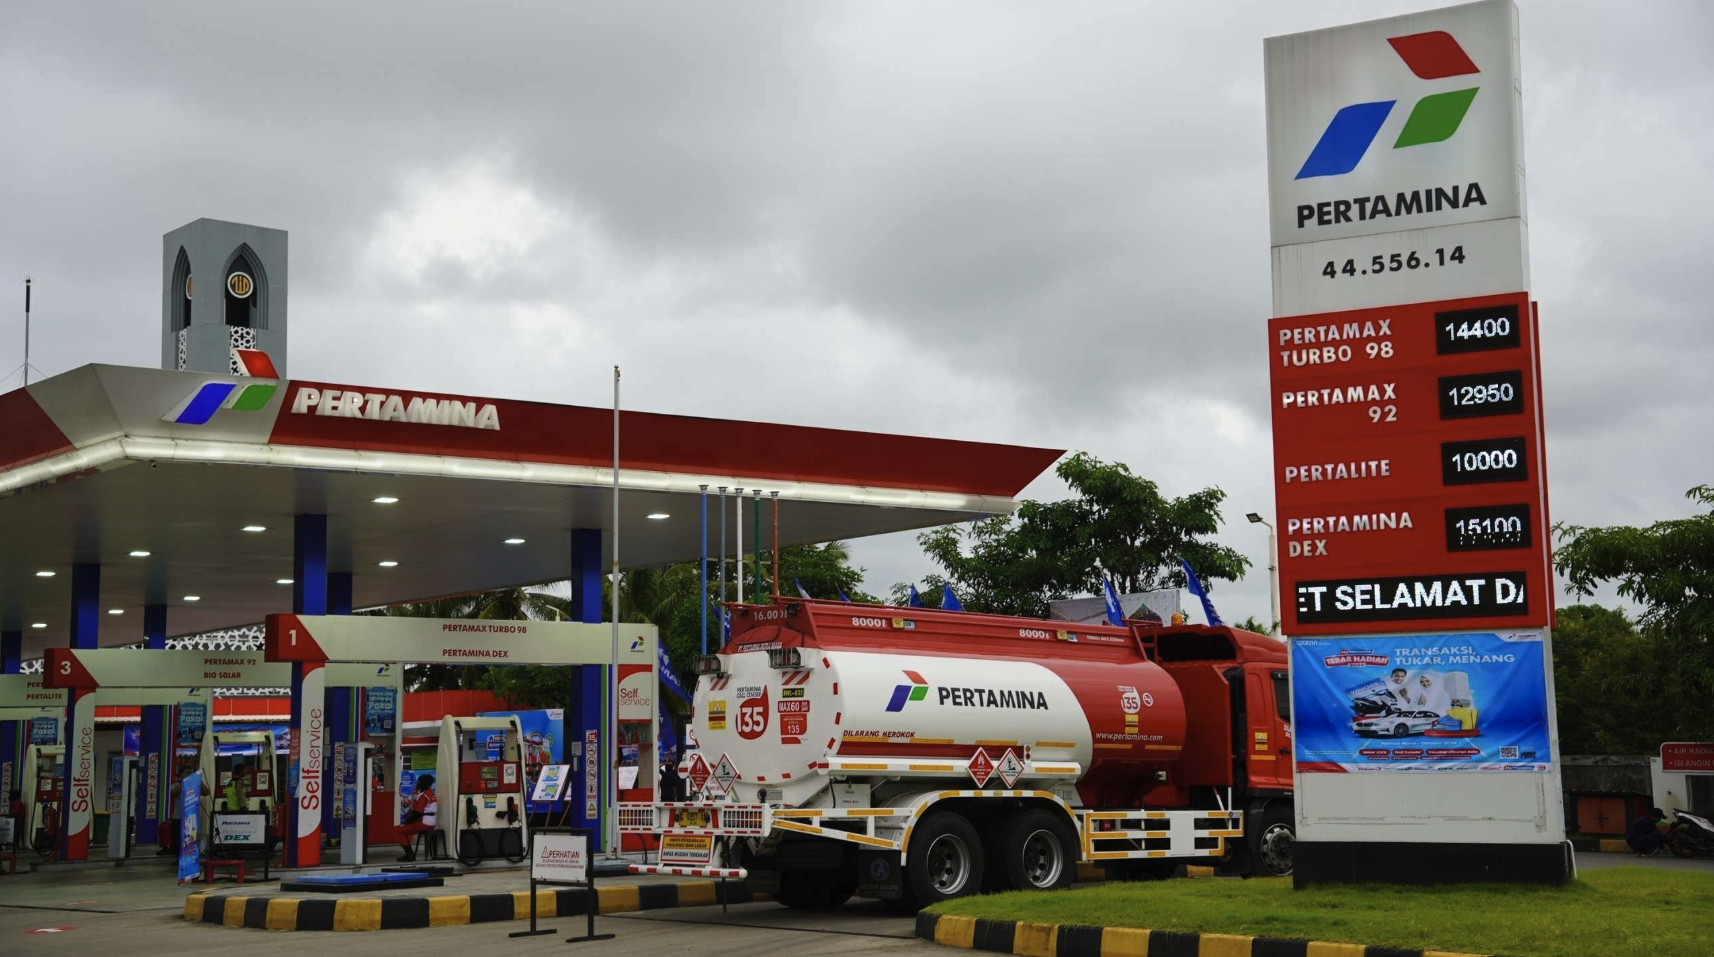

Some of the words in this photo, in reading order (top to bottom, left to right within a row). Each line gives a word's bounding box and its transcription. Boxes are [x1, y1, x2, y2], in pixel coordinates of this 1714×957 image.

[1297, 182, 1487, 229] PERTAMINA
[1321, 245, 1466, 279] 44.556.14
[1279, 318, 1392, 346] PERTAMAX
[1445, 317, 1510, 341] 14400
[1280, 345, 1352, 367] TURBO
[1365, 341, 1394, 359] 98
[1282, 383, 1397, 409] PERTAMAX
[1448, 382, 1514, 406] 12950
[291, 387, 500, 431] PERTAMINA
[1368, 404, 1397, 423] 92
[1451, 449, 1517, 472] 10000
[1285, 459, 1390, 483] PERTALITE
[1287, 511, 1413, 535] PERTAMINA
[1288, 539, 1328, 558] DEX
[1335, 579, 1485, 611] SELAMAT
[1495, 577, 1524, 605] D
[289, 629, 296, 645] 1
[442, 624, 487, 632] PERTAMAX
[488, 625, 516, 634] TURBO
[517, 626, 527, 634] 98
[442, 649, 490, 658] PERTAMINA
[492, 650, 508, 658] DEX
[1325, 656, 1352, 664] TEBAR
[1353, 655, 1389, 664] HADIAH
[1394, 646, 1477, 657] TRANSAKSI,
[1394, 656, 1446, 666] TUKAR,
[1448, 654, 1516, 664] MENANG
[60, 661, 71, 675] 3
[204, 658, 245, 666] PERTAMAX
[247, 658, 256, 666] 92
[620, 687, 638, 699] Self
[620, 697, 650, 706] service
[937, 686, 1049, 711] PERTAMINA
[1122, 696, 1139, 710] 135
[737, 706, 765, 733] 135
[787, 725, 800, 734] 135
[843, 729, 879, 738] DILARANG
[882, 730, 916, 738] MEROKOK
[549, 850, 579, 859] PERHATIAN
